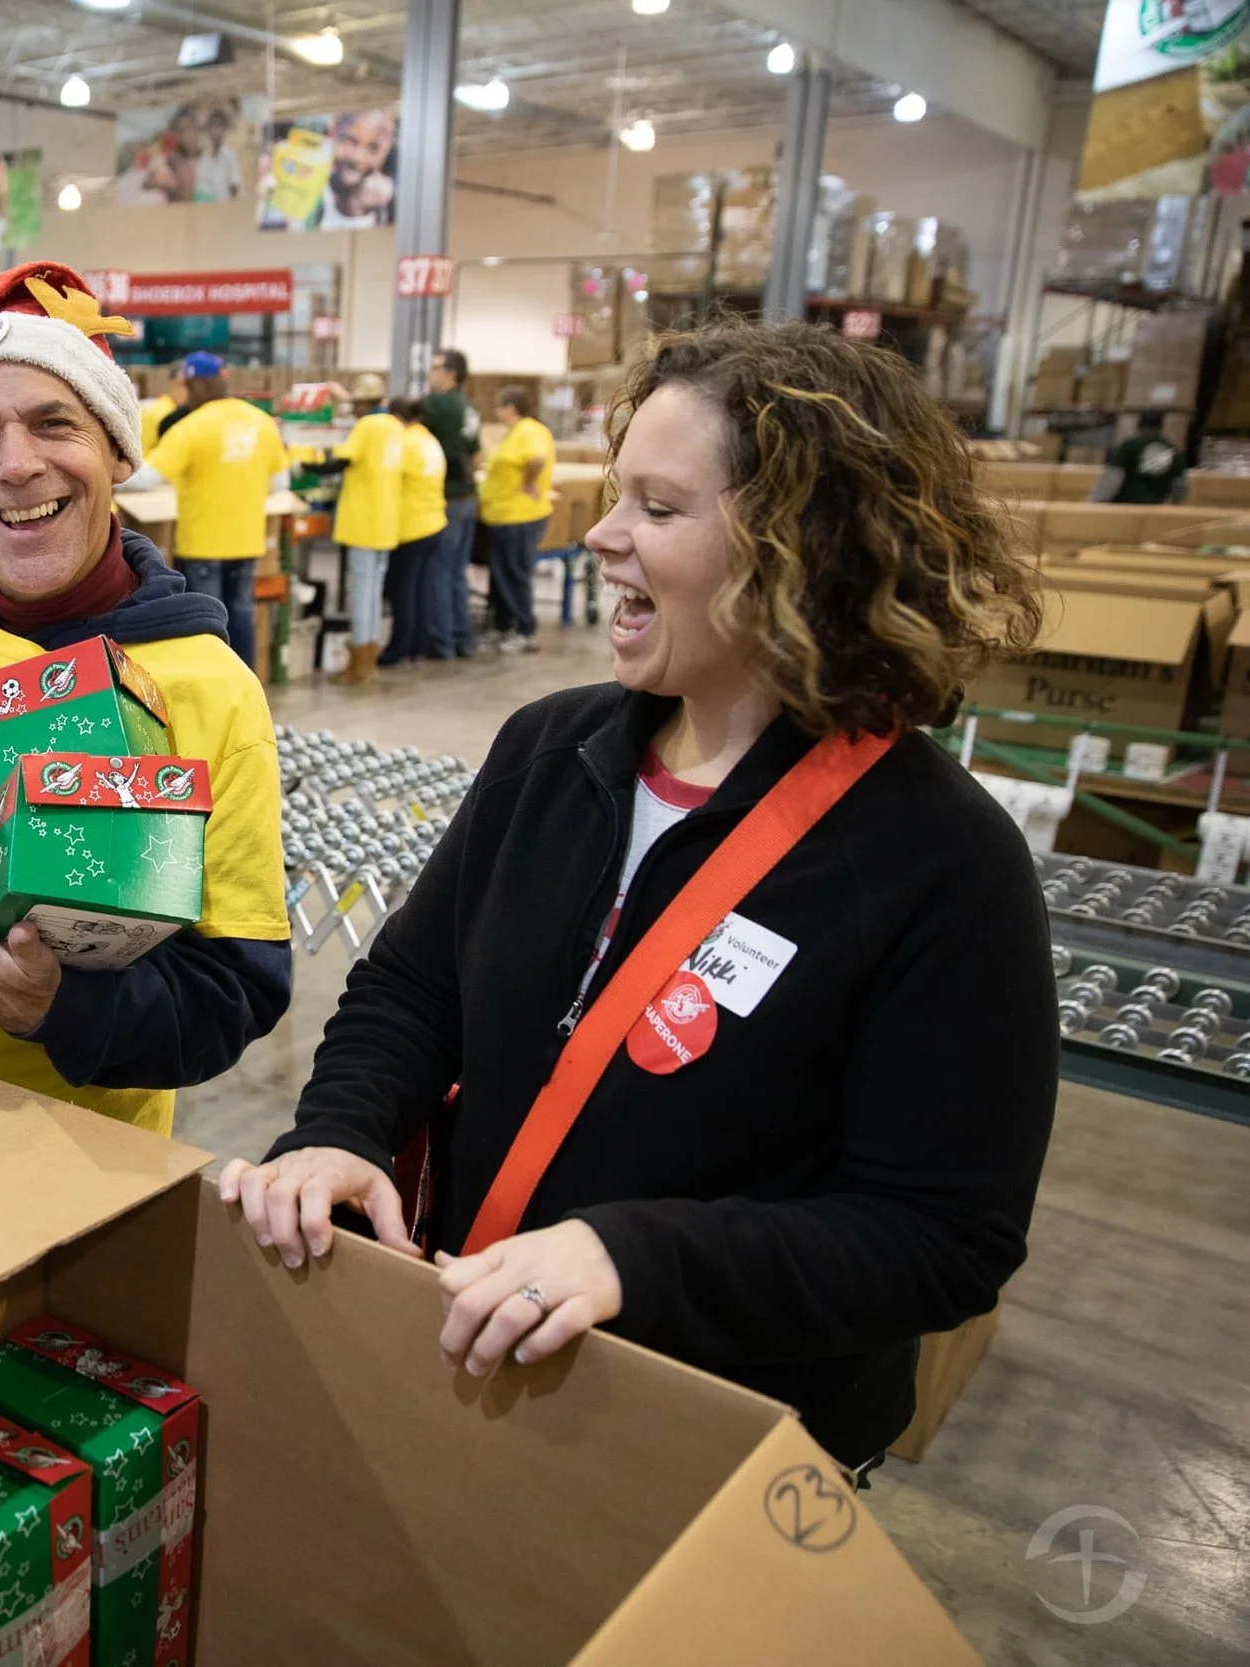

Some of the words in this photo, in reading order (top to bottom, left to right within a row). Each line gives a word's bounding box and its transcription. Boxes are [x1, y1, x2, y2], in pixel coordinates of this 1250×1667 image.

[1025, 674, 1117, 713] Purse
[727, 935, 780, 971] Volunteer
[644, 1005, 692, 1064] HAPERONE
[776, 1466, 845, 1544] 23
